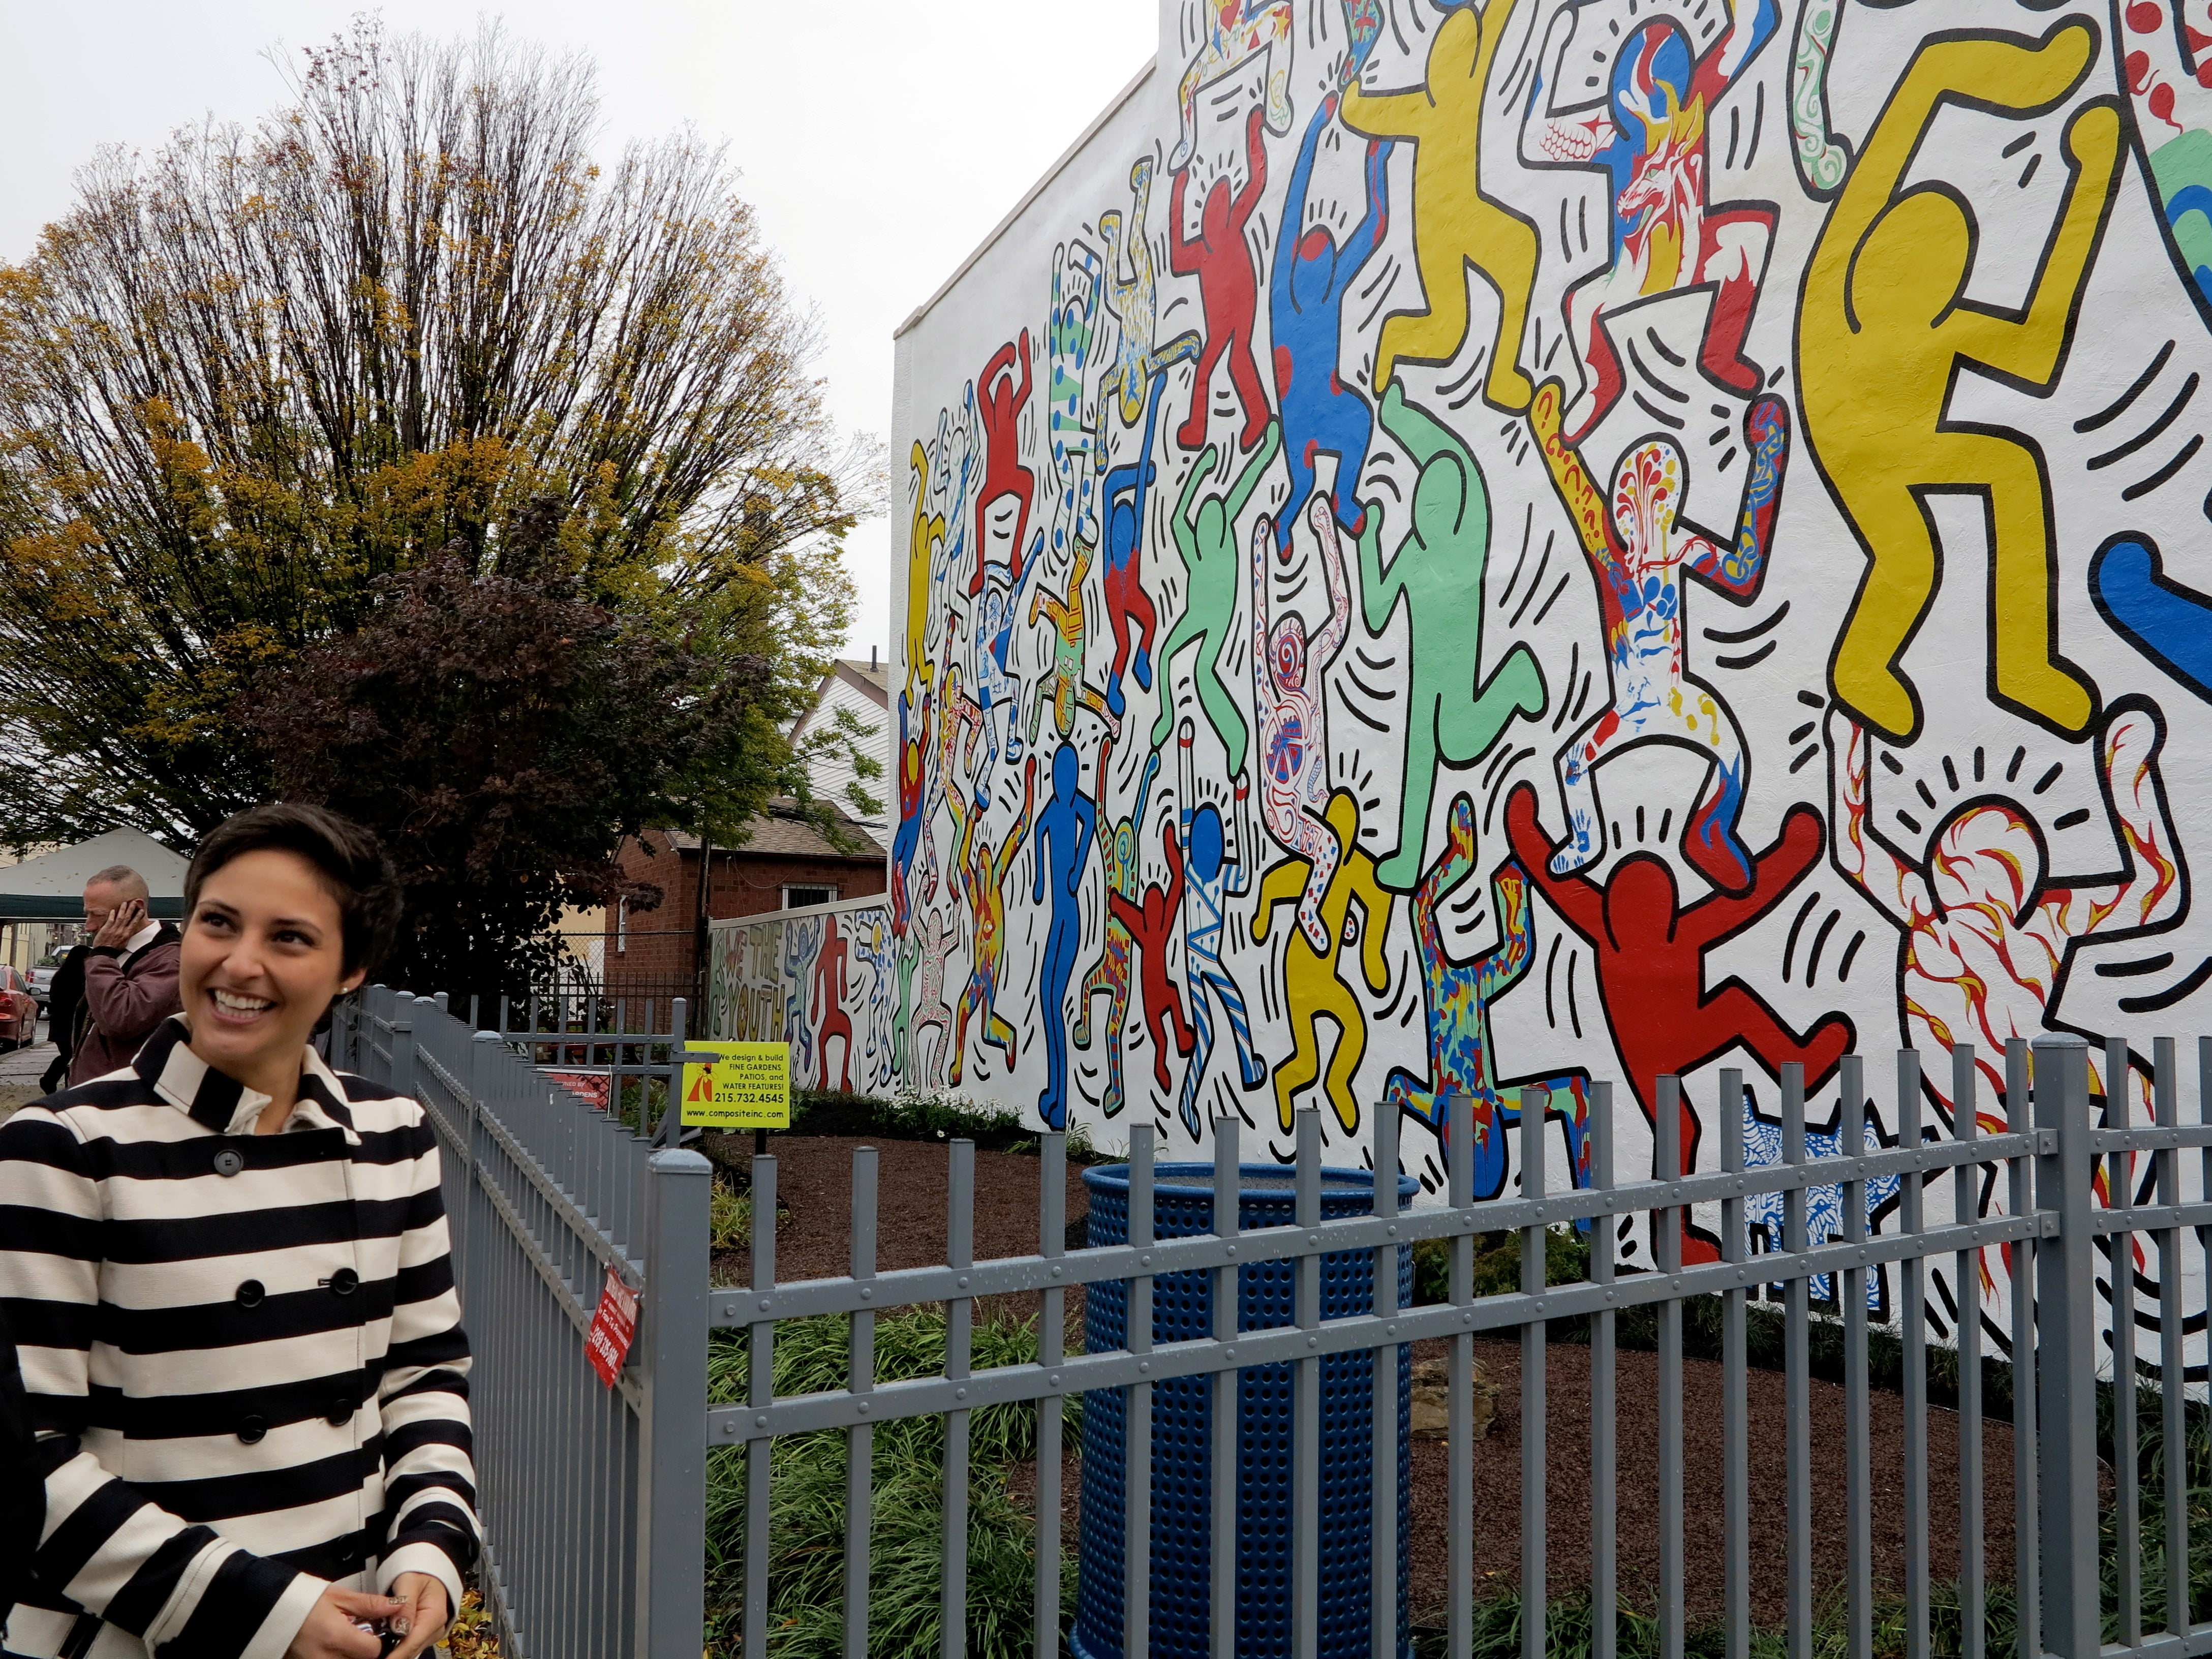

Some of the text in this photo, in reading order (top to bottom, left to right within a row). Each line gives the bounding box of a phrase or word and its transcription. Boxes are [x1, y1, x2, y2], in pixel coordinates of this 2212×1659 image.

[725, 921, 782, 985] WE THE
[728, 982, 785, 1042] YOUTH
[731, 1054, 756, 1062] design
[715, 1093, 784, 1103] 215.732.4545
[687, 1109, 784, 1119] www.compositeinc.com
